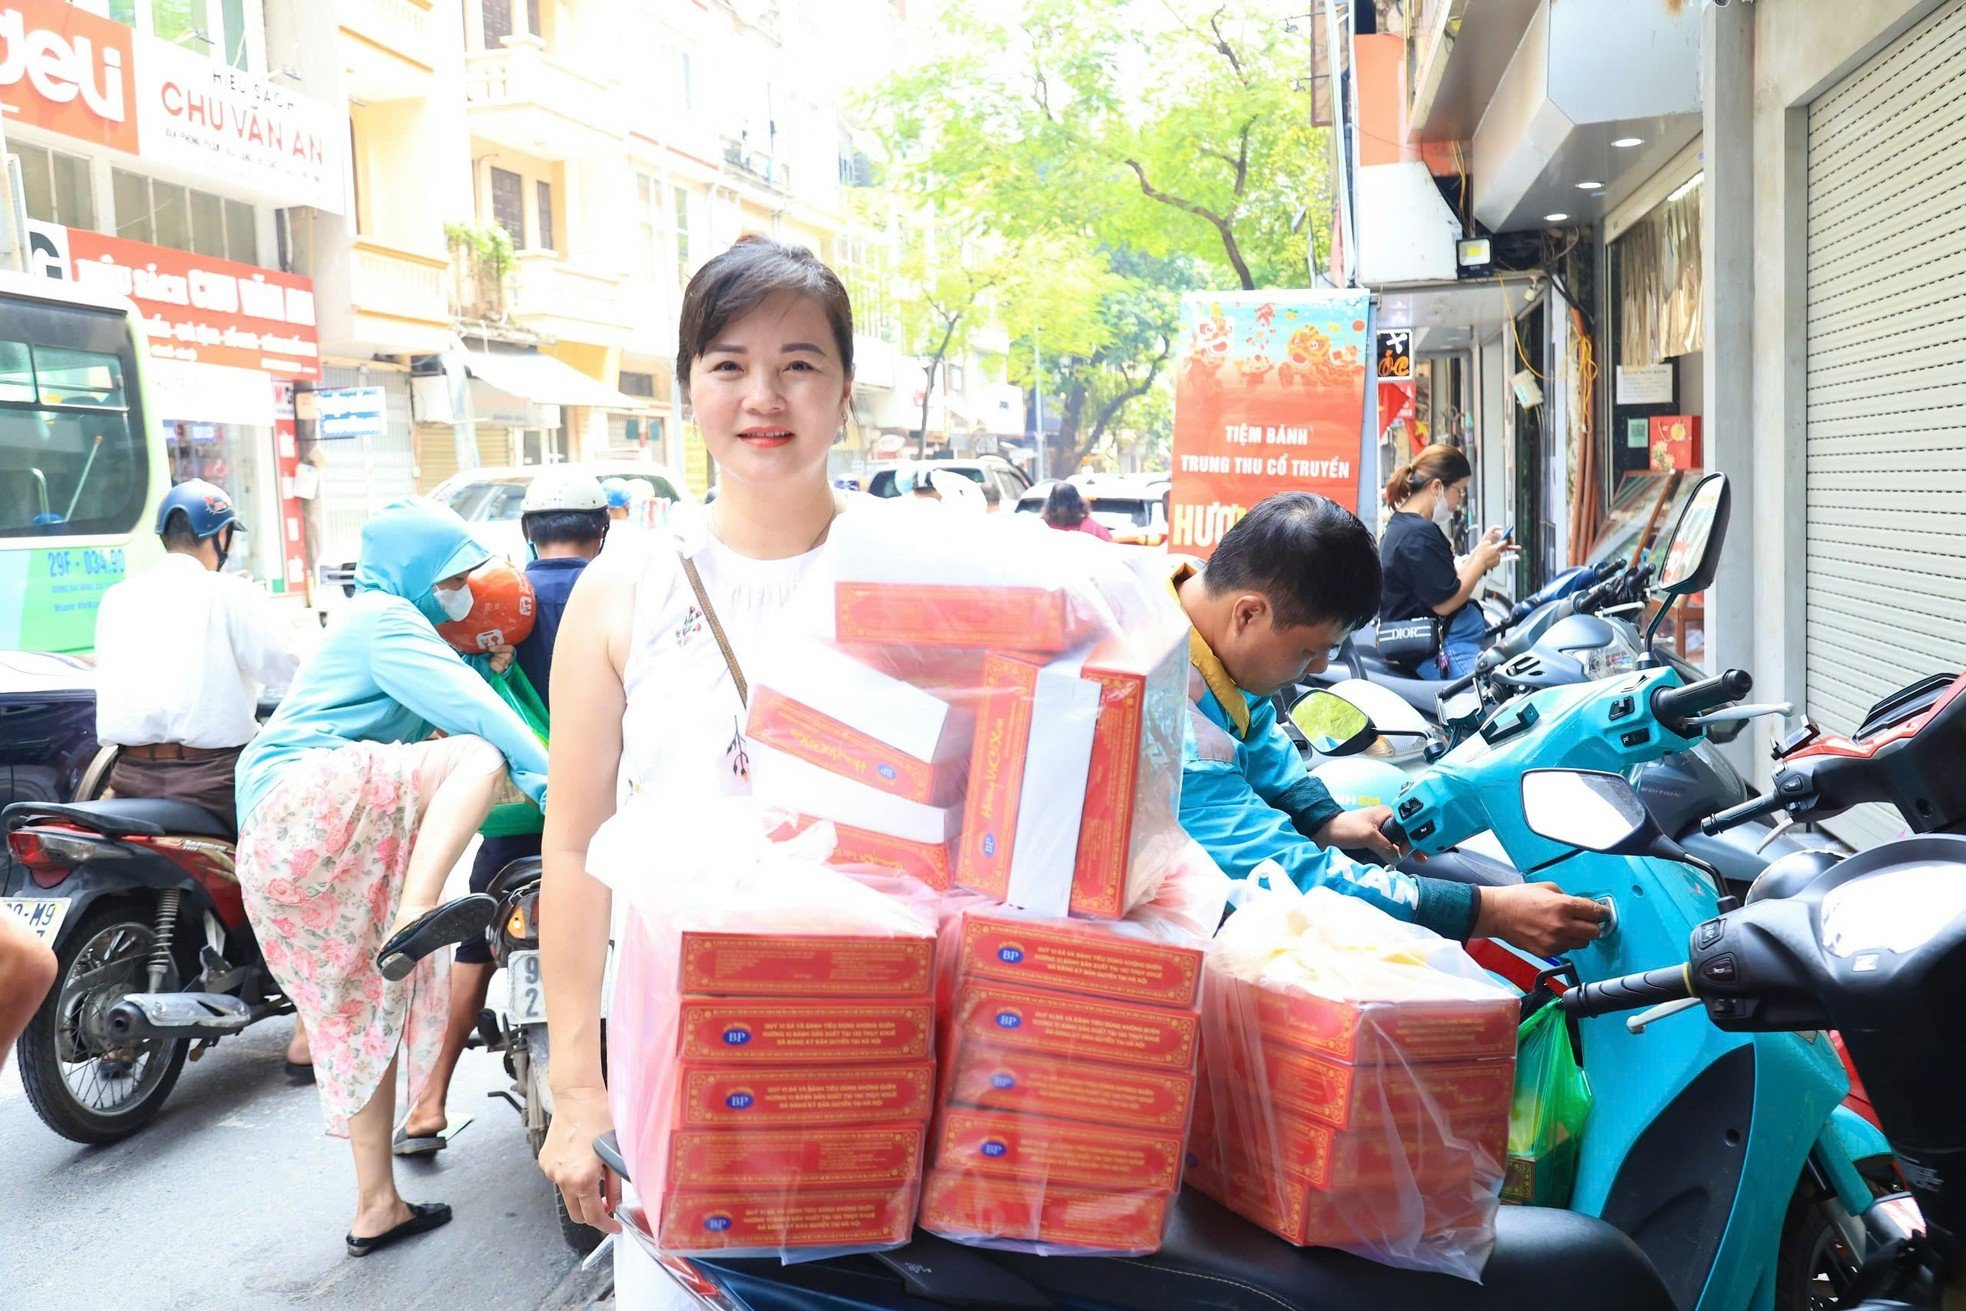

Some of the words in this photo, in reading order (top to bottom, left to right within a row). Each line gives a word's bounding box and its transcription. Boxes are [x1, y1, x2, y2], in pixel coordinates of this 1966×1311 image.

[162, 81, 223, 130] CHU
[231, 104, 282, 150] VĂN
[293, 130, 322, 164] AN
[1225, 422, 1262, 446] TIỆM
[1266, 424, 1308, 445] BÁNH
[1180, 454, 1230, 473] TRUNG
[1234, 456, 1263, 474] THU
[1266, 453, 1288, 475] CỔ
[1291, 456, 1350, 478] TRUYỀN
[1391, 627, 1418, 640] DIOR
[1002, 950, 1019, 961] BP
[1000, 1015, 1017, 1026] BP
[729, 1032, 745, 1042] BP
[732, 1097, 748, 1106] BP
